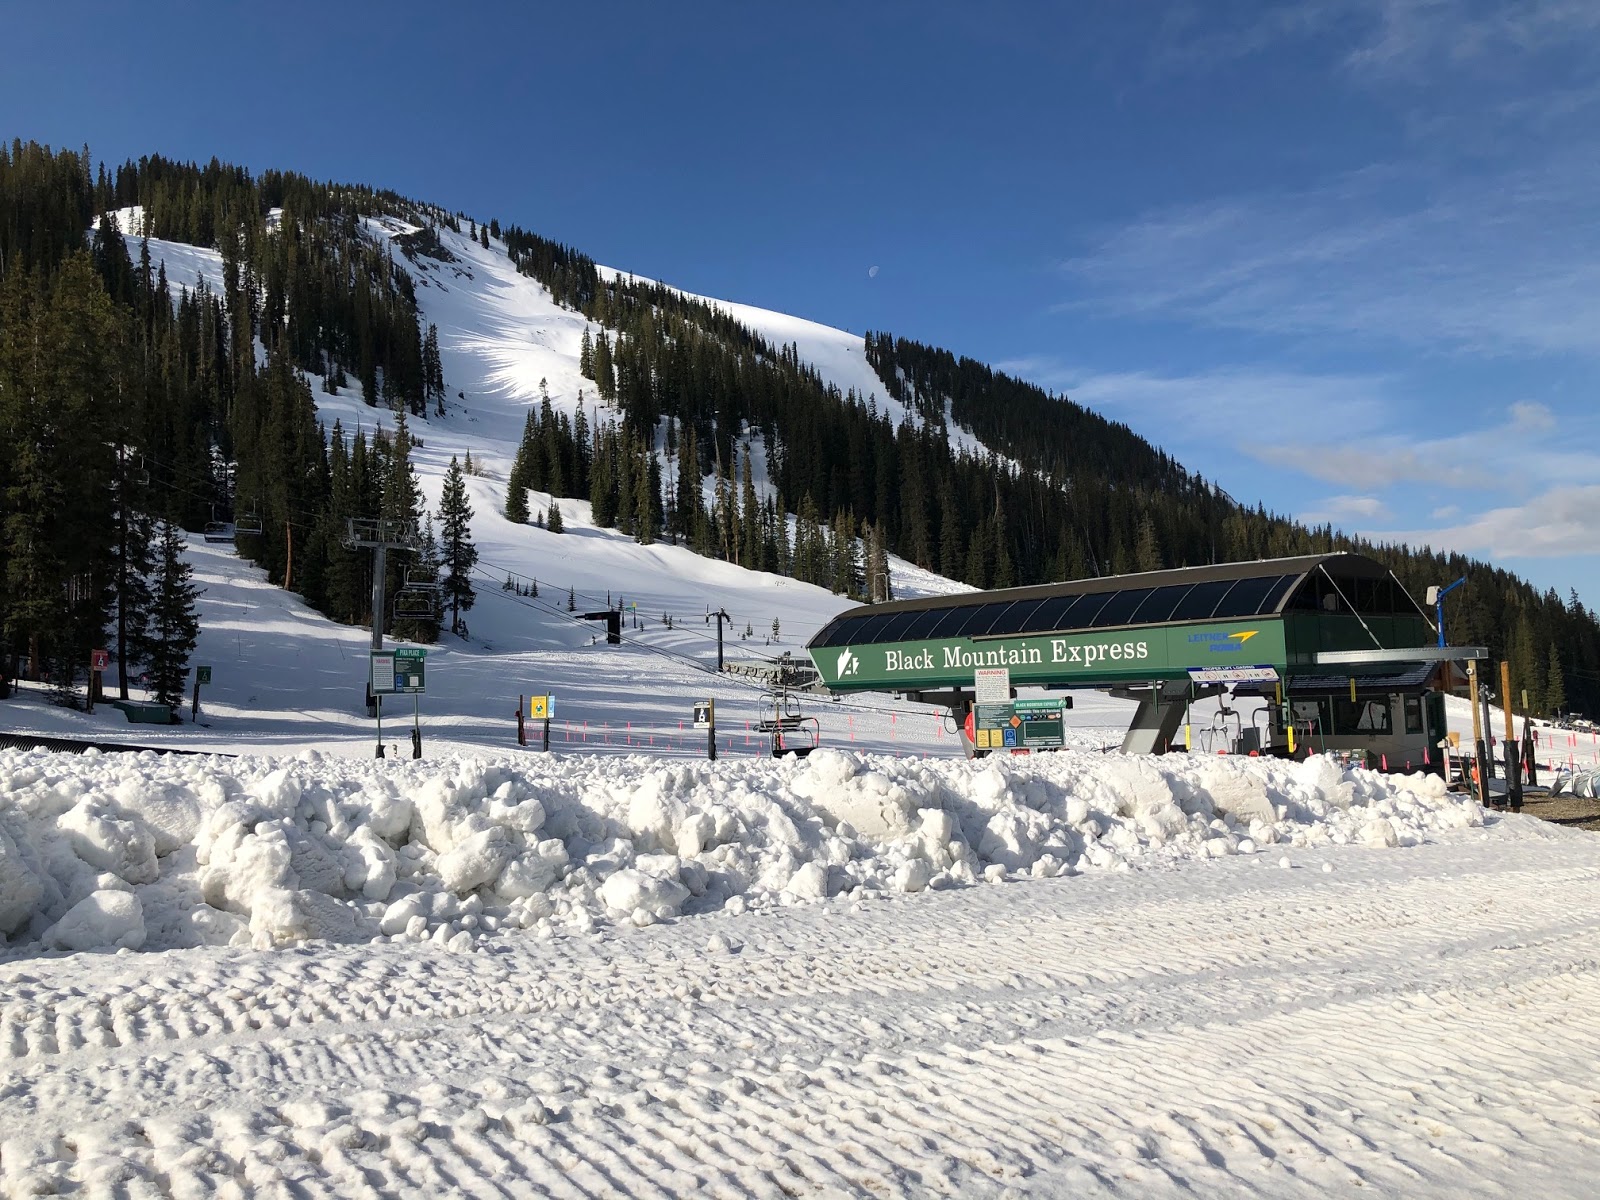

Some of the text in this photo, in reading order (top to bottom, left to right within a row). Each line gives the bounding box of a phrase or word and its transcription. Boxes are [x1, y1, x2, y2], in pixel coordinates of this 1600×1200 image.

[885, 639, 1148, 671] Black Mountain Express
